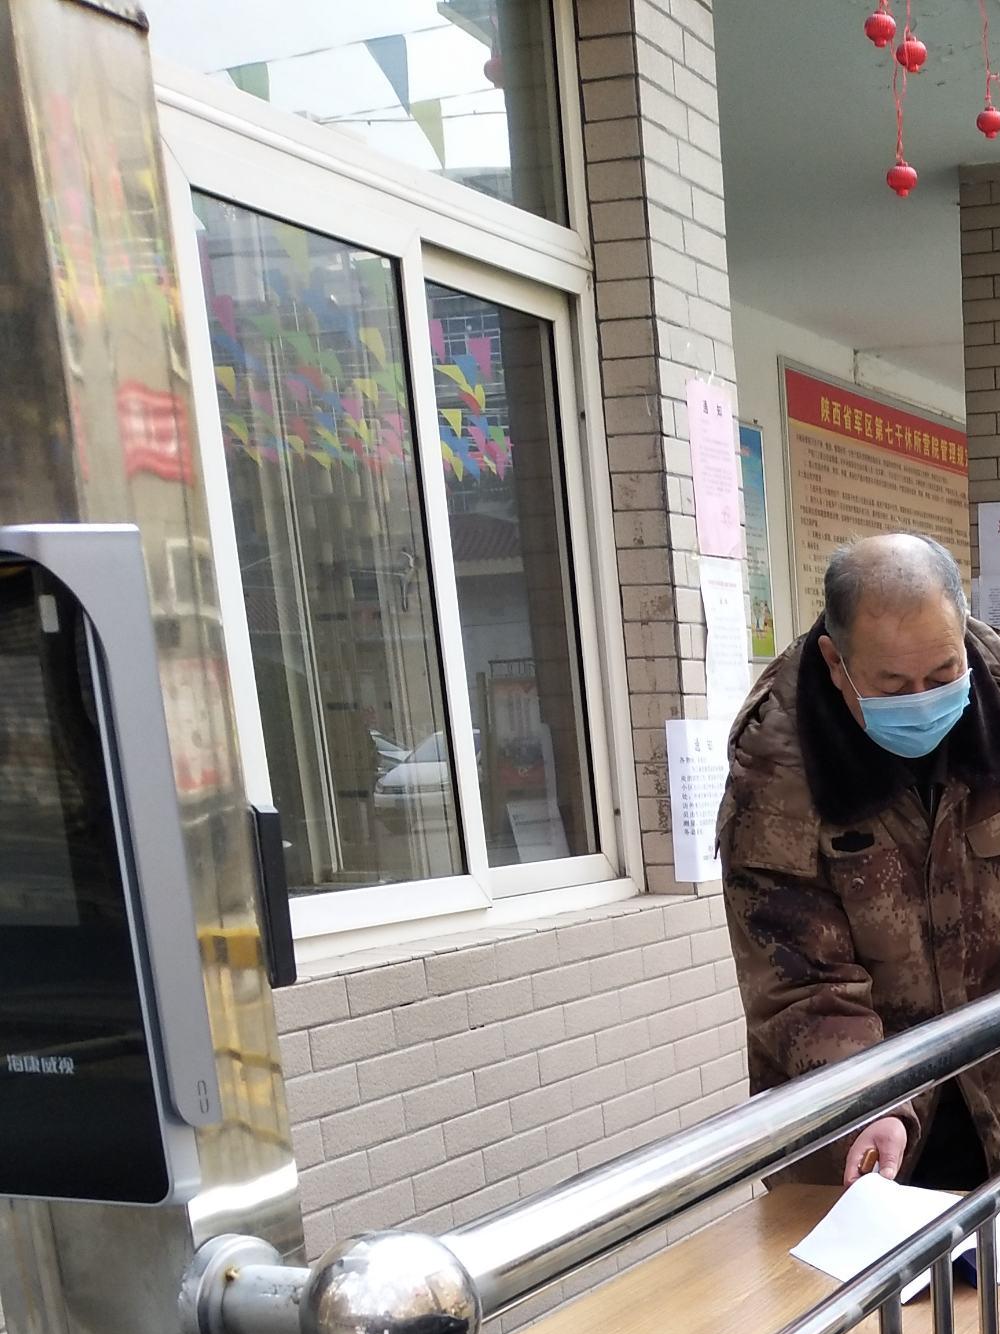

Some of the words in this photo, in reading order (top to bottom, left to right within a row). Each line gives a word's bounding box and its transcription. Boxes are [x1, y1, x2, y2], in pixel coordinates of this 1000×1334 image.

[820, 396, 969, 468] 陕西省军区第七干休所营院管理规
